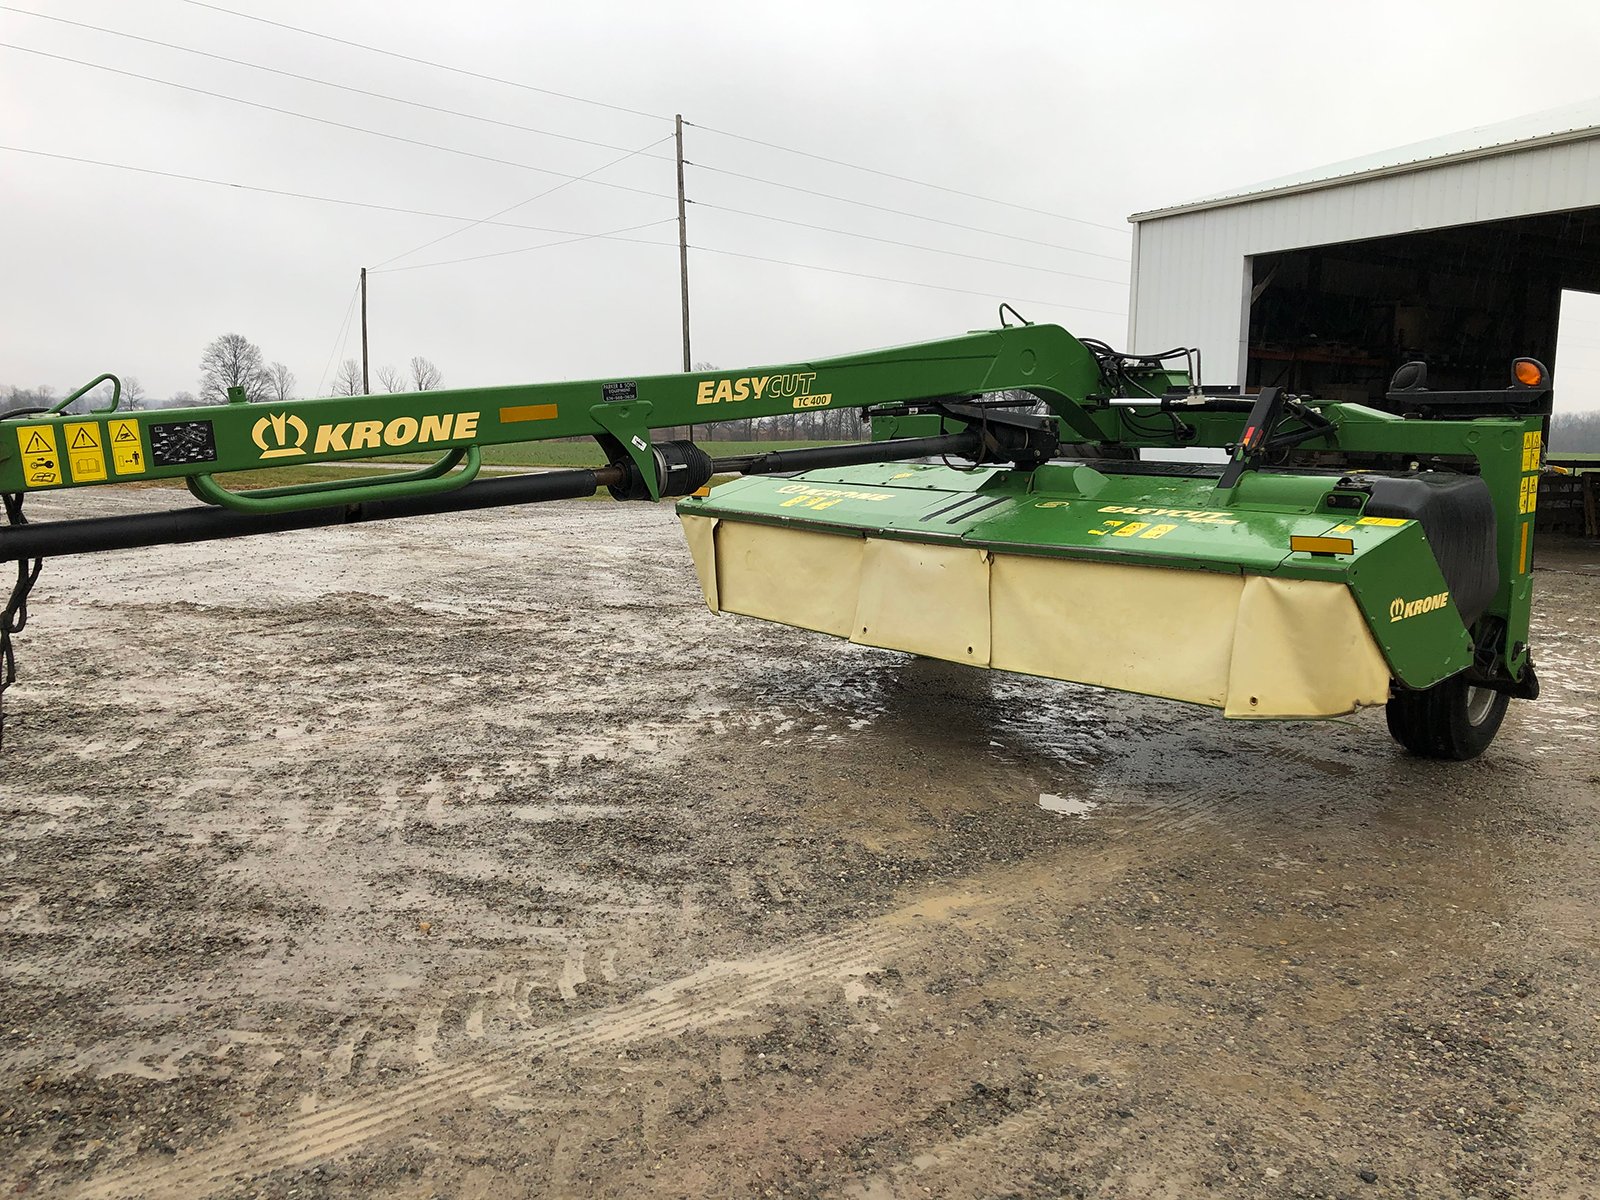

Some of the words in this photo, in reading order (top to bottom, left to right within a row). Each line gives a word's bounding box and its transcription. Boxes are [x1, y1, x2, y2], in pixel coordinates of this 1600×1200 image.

[696, 372, 816, 405] EASYCUT
[798, 397, 809, 407] TC
[810, 395, 827, 406] 400
[314, 411, 480, 454] KRONE
[1403, 591, 1450, 619] KRONE
